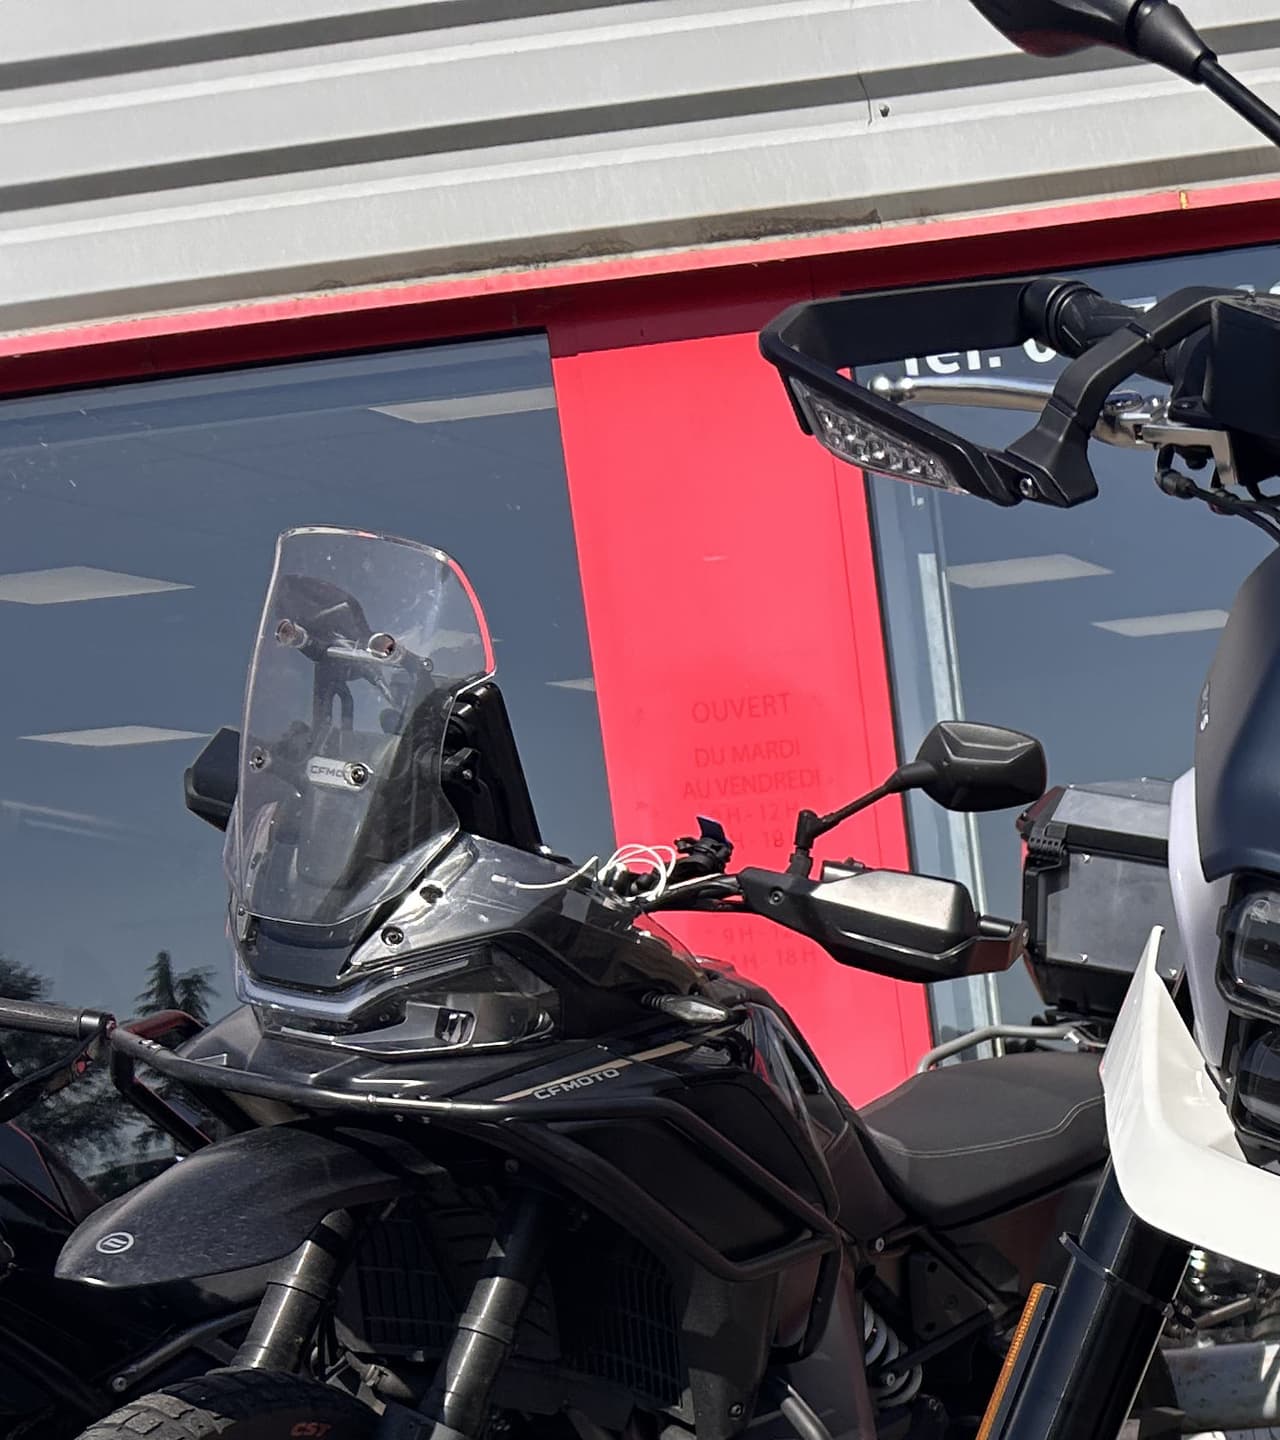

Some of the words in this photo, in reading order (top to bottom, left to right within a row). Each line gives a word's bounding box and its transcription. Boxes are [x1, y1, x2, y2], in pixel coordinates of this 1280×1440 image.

[691, 692, 791, 723] OUVERT
[694, 745, 725, 768] DU
[731, 738, 800, 763] MARDI
[310, 765, 346, 778] CFMO
[683, 778, 711, 800] AU
[715, 768, 820, 796] VENDREDI
[533, 1068, 621, 1100] CFMOTO
[290, 1421, 332, 1438] CST
